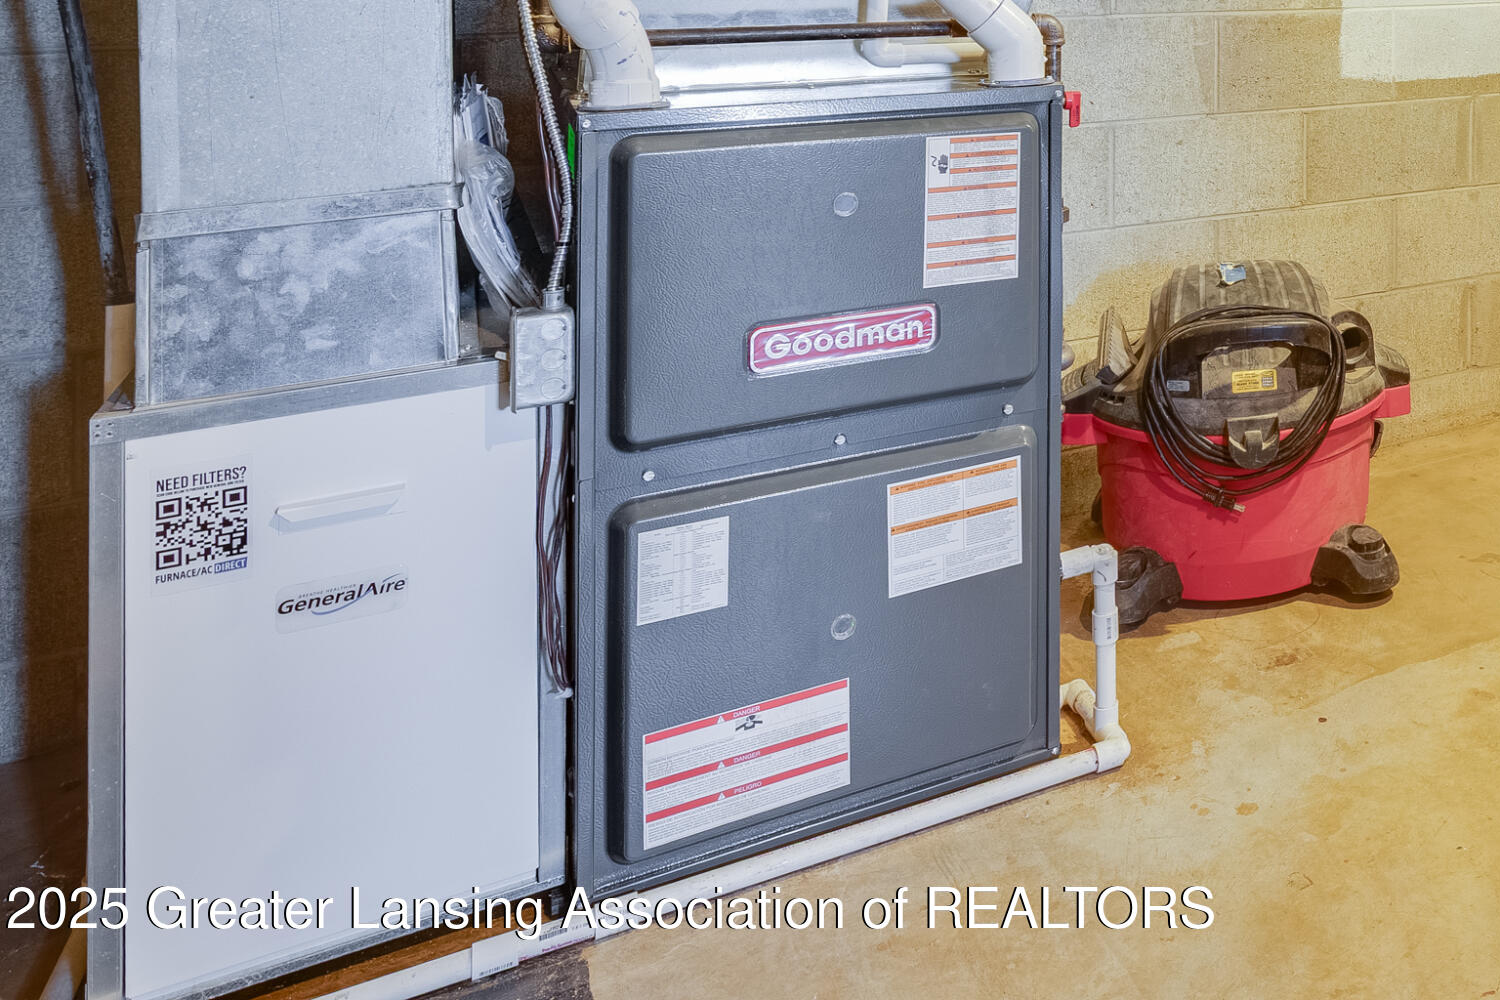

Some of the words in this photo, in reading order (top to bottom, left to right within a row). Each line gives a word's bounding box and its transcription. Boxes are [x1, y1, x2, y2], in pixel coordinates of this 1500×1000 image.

[765, 319, 923, 360] Goodman
[156, 475, 189, 492] NEED
[192, 465, 247, 487] FILTERS?
[155, 564, 213, 584] FURNACE/AC
[214, 558, 246, 573] DIRECT
[277, 579, 406, 615] GeneralAire
[732, 705, 761, 719] DANGER
[733, 750, 761, 764] DANGER
[733, 781, 763, 794] PELIGRO
